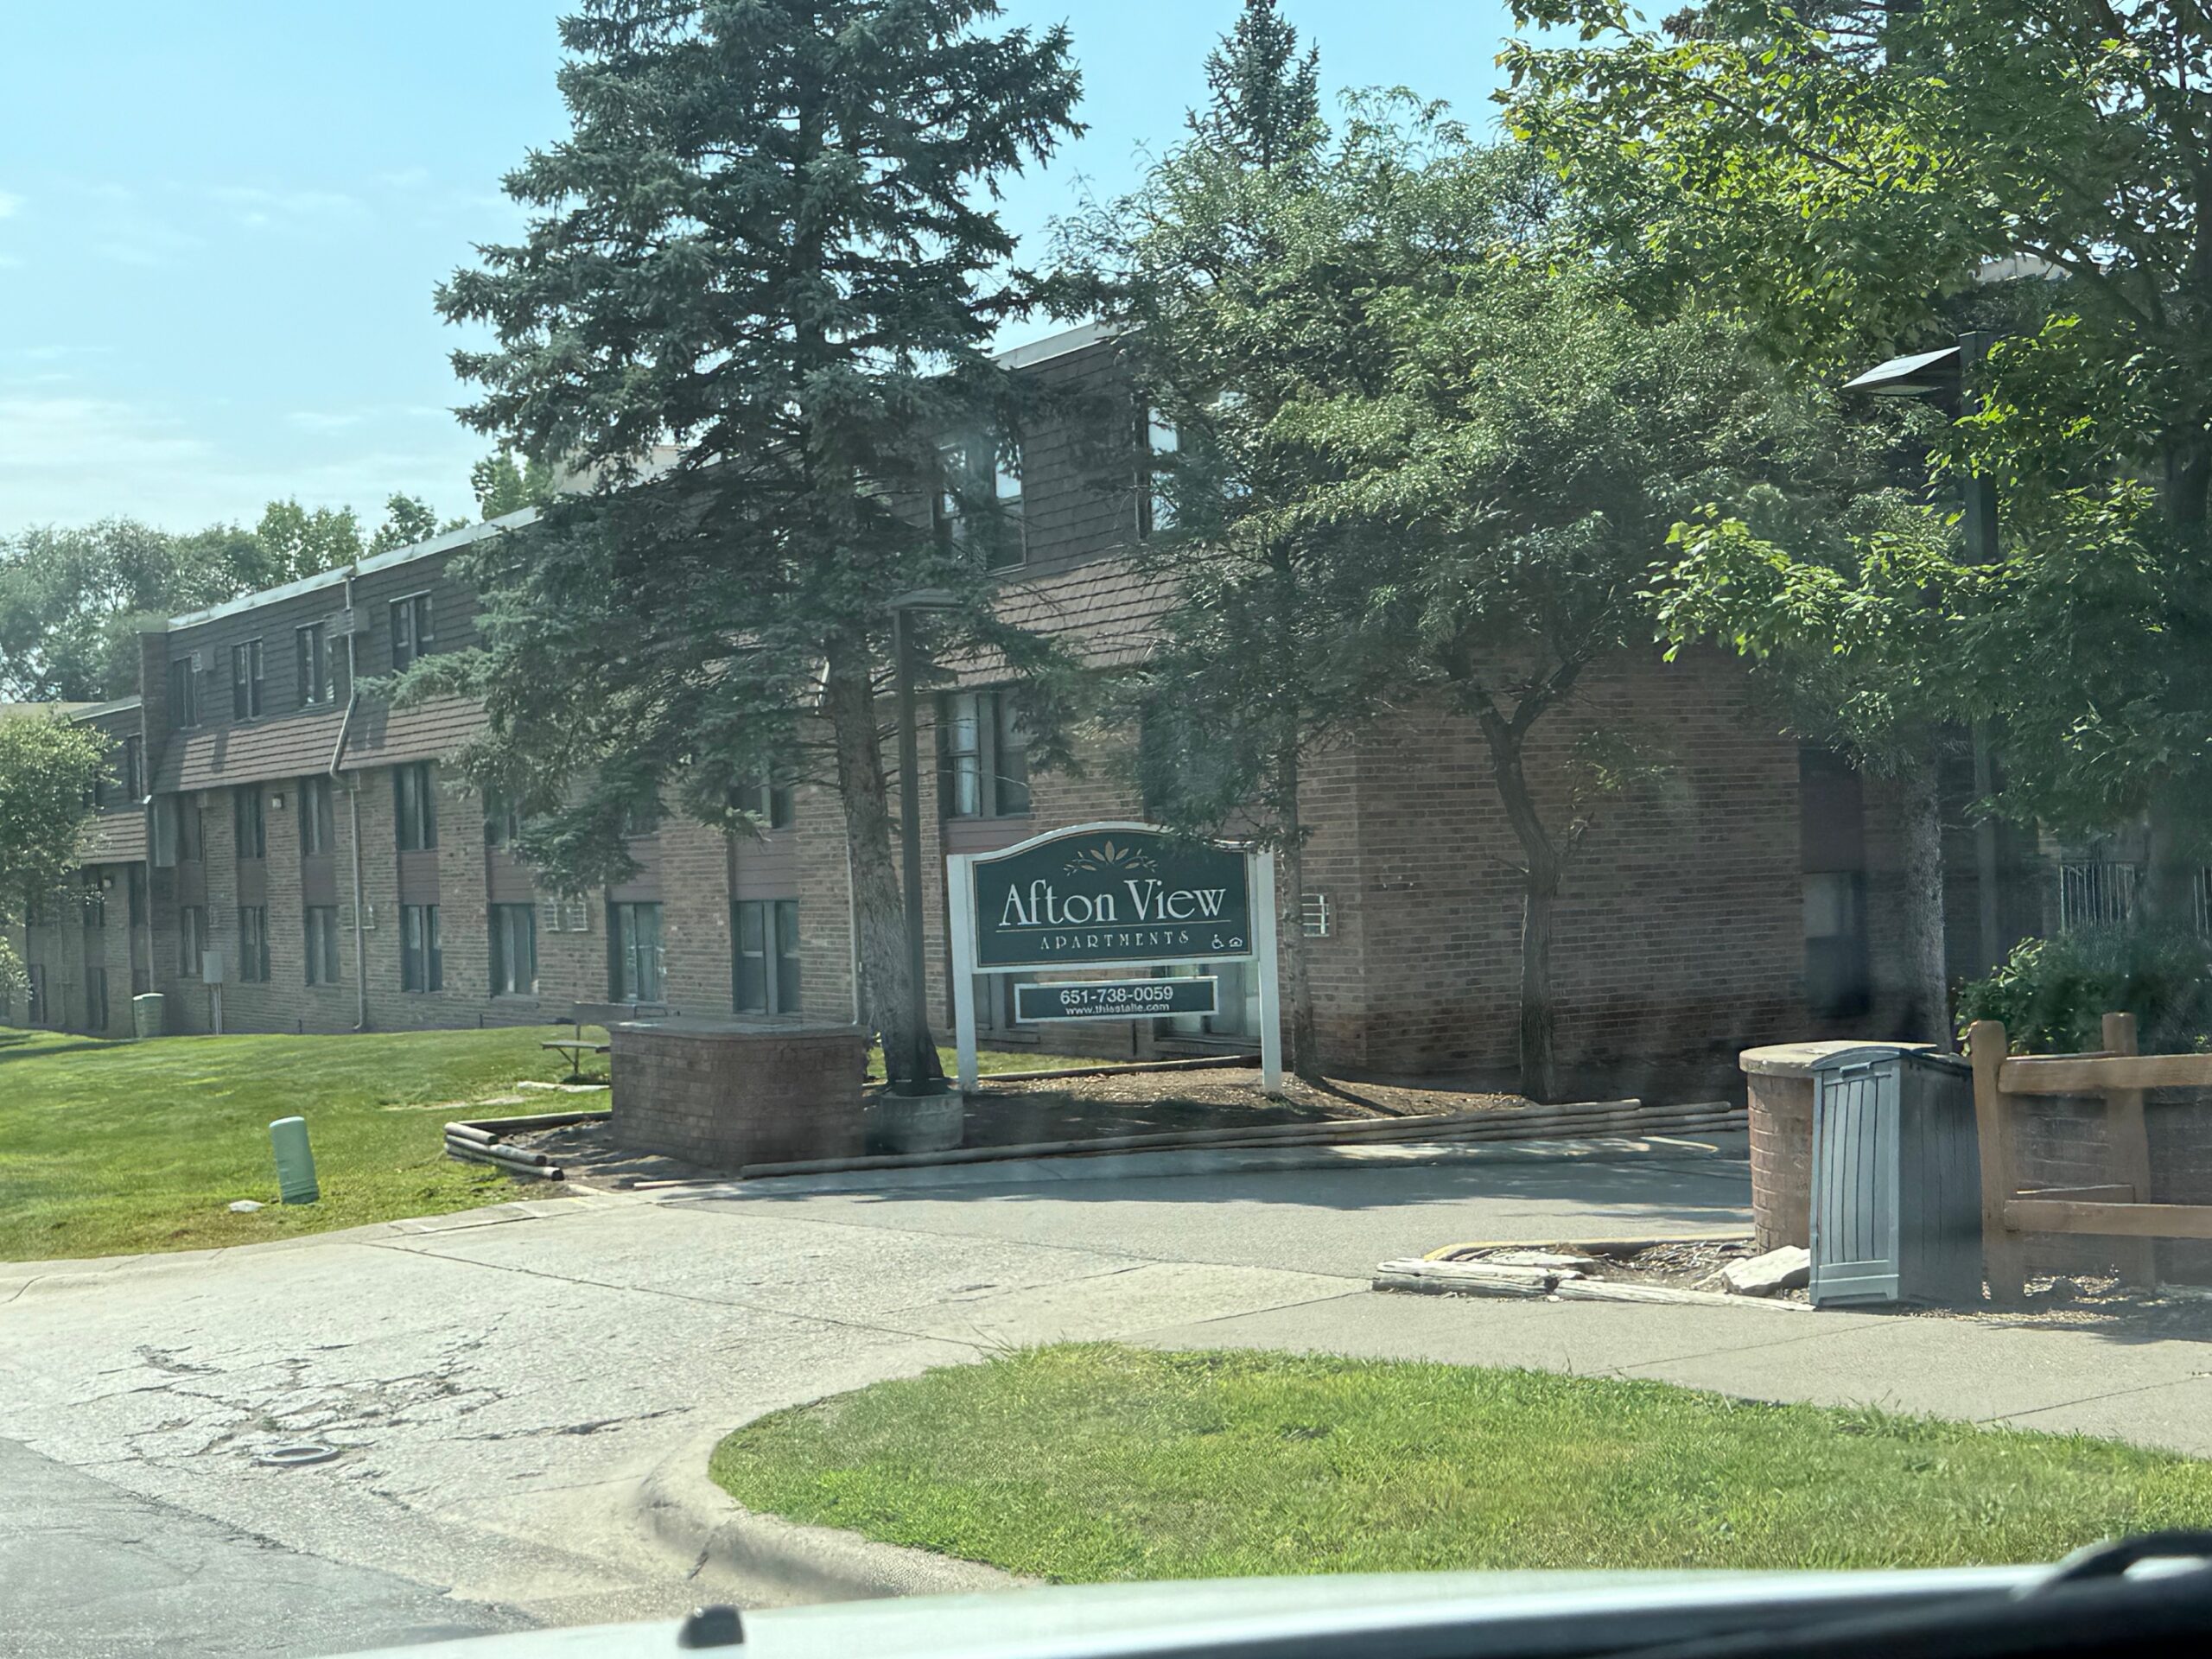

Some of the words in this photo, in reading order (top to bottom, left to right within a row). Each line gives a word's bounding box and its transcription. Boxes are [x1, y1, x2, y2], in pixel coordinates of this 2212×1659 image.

[998, 879, 1118, 926] Afton
[1123, 879, 1226, 921] View
[1040, 930, 1189, 950] APARTMENTS
[1059, 986, 1173, 1004] 651-738-0059
